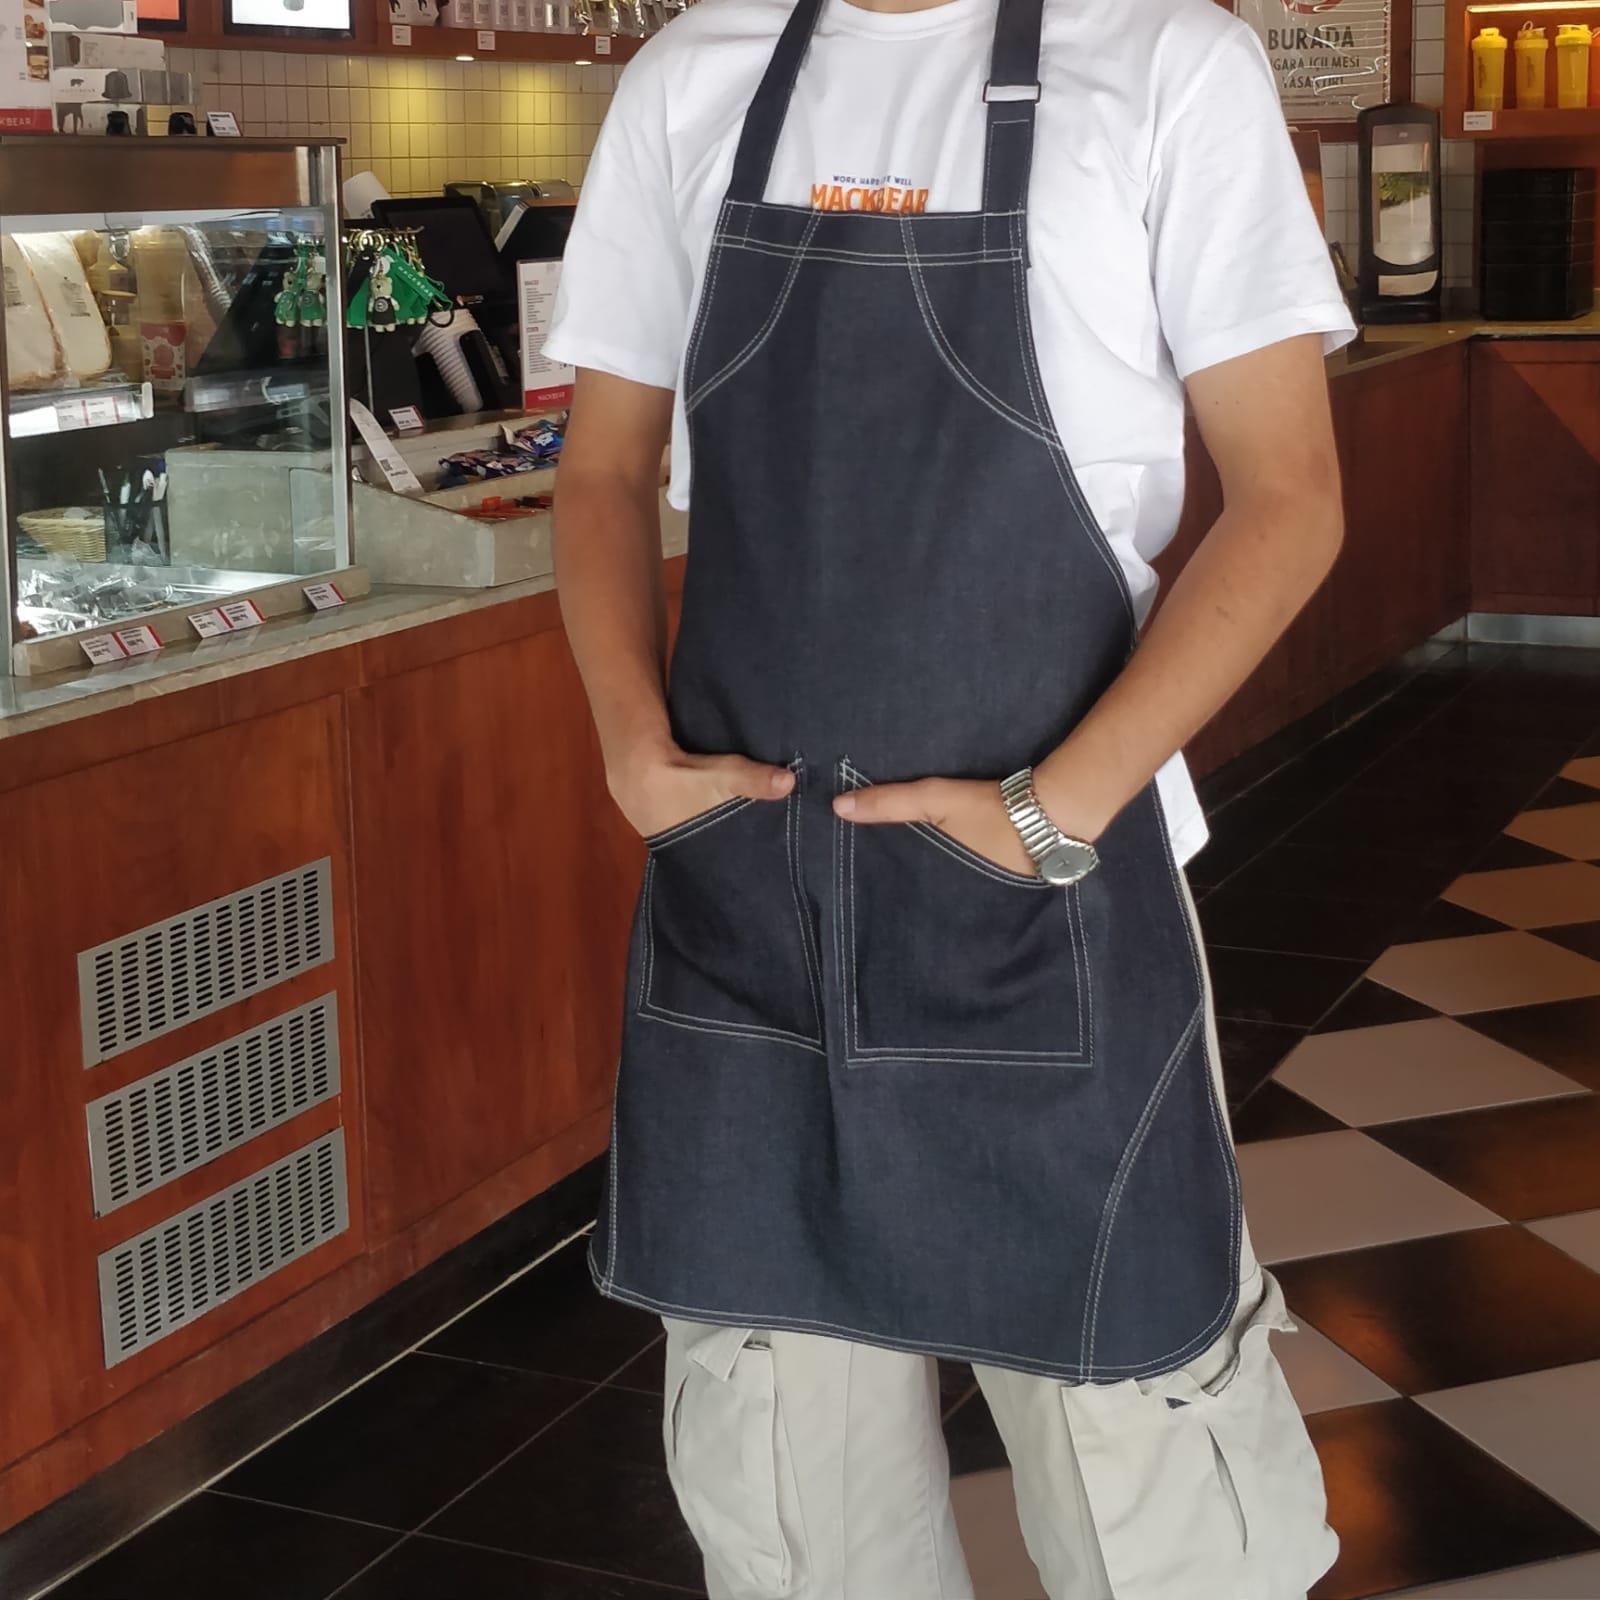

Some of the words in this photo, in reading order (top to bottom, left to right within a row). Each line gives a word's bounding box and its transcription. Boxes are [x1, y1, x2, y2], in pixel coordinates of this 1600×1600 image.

[1267, 26, 1354, 50] BURADA
[833, 175, 857, 185] WORK
[894, 175, 912, 186] WELL
